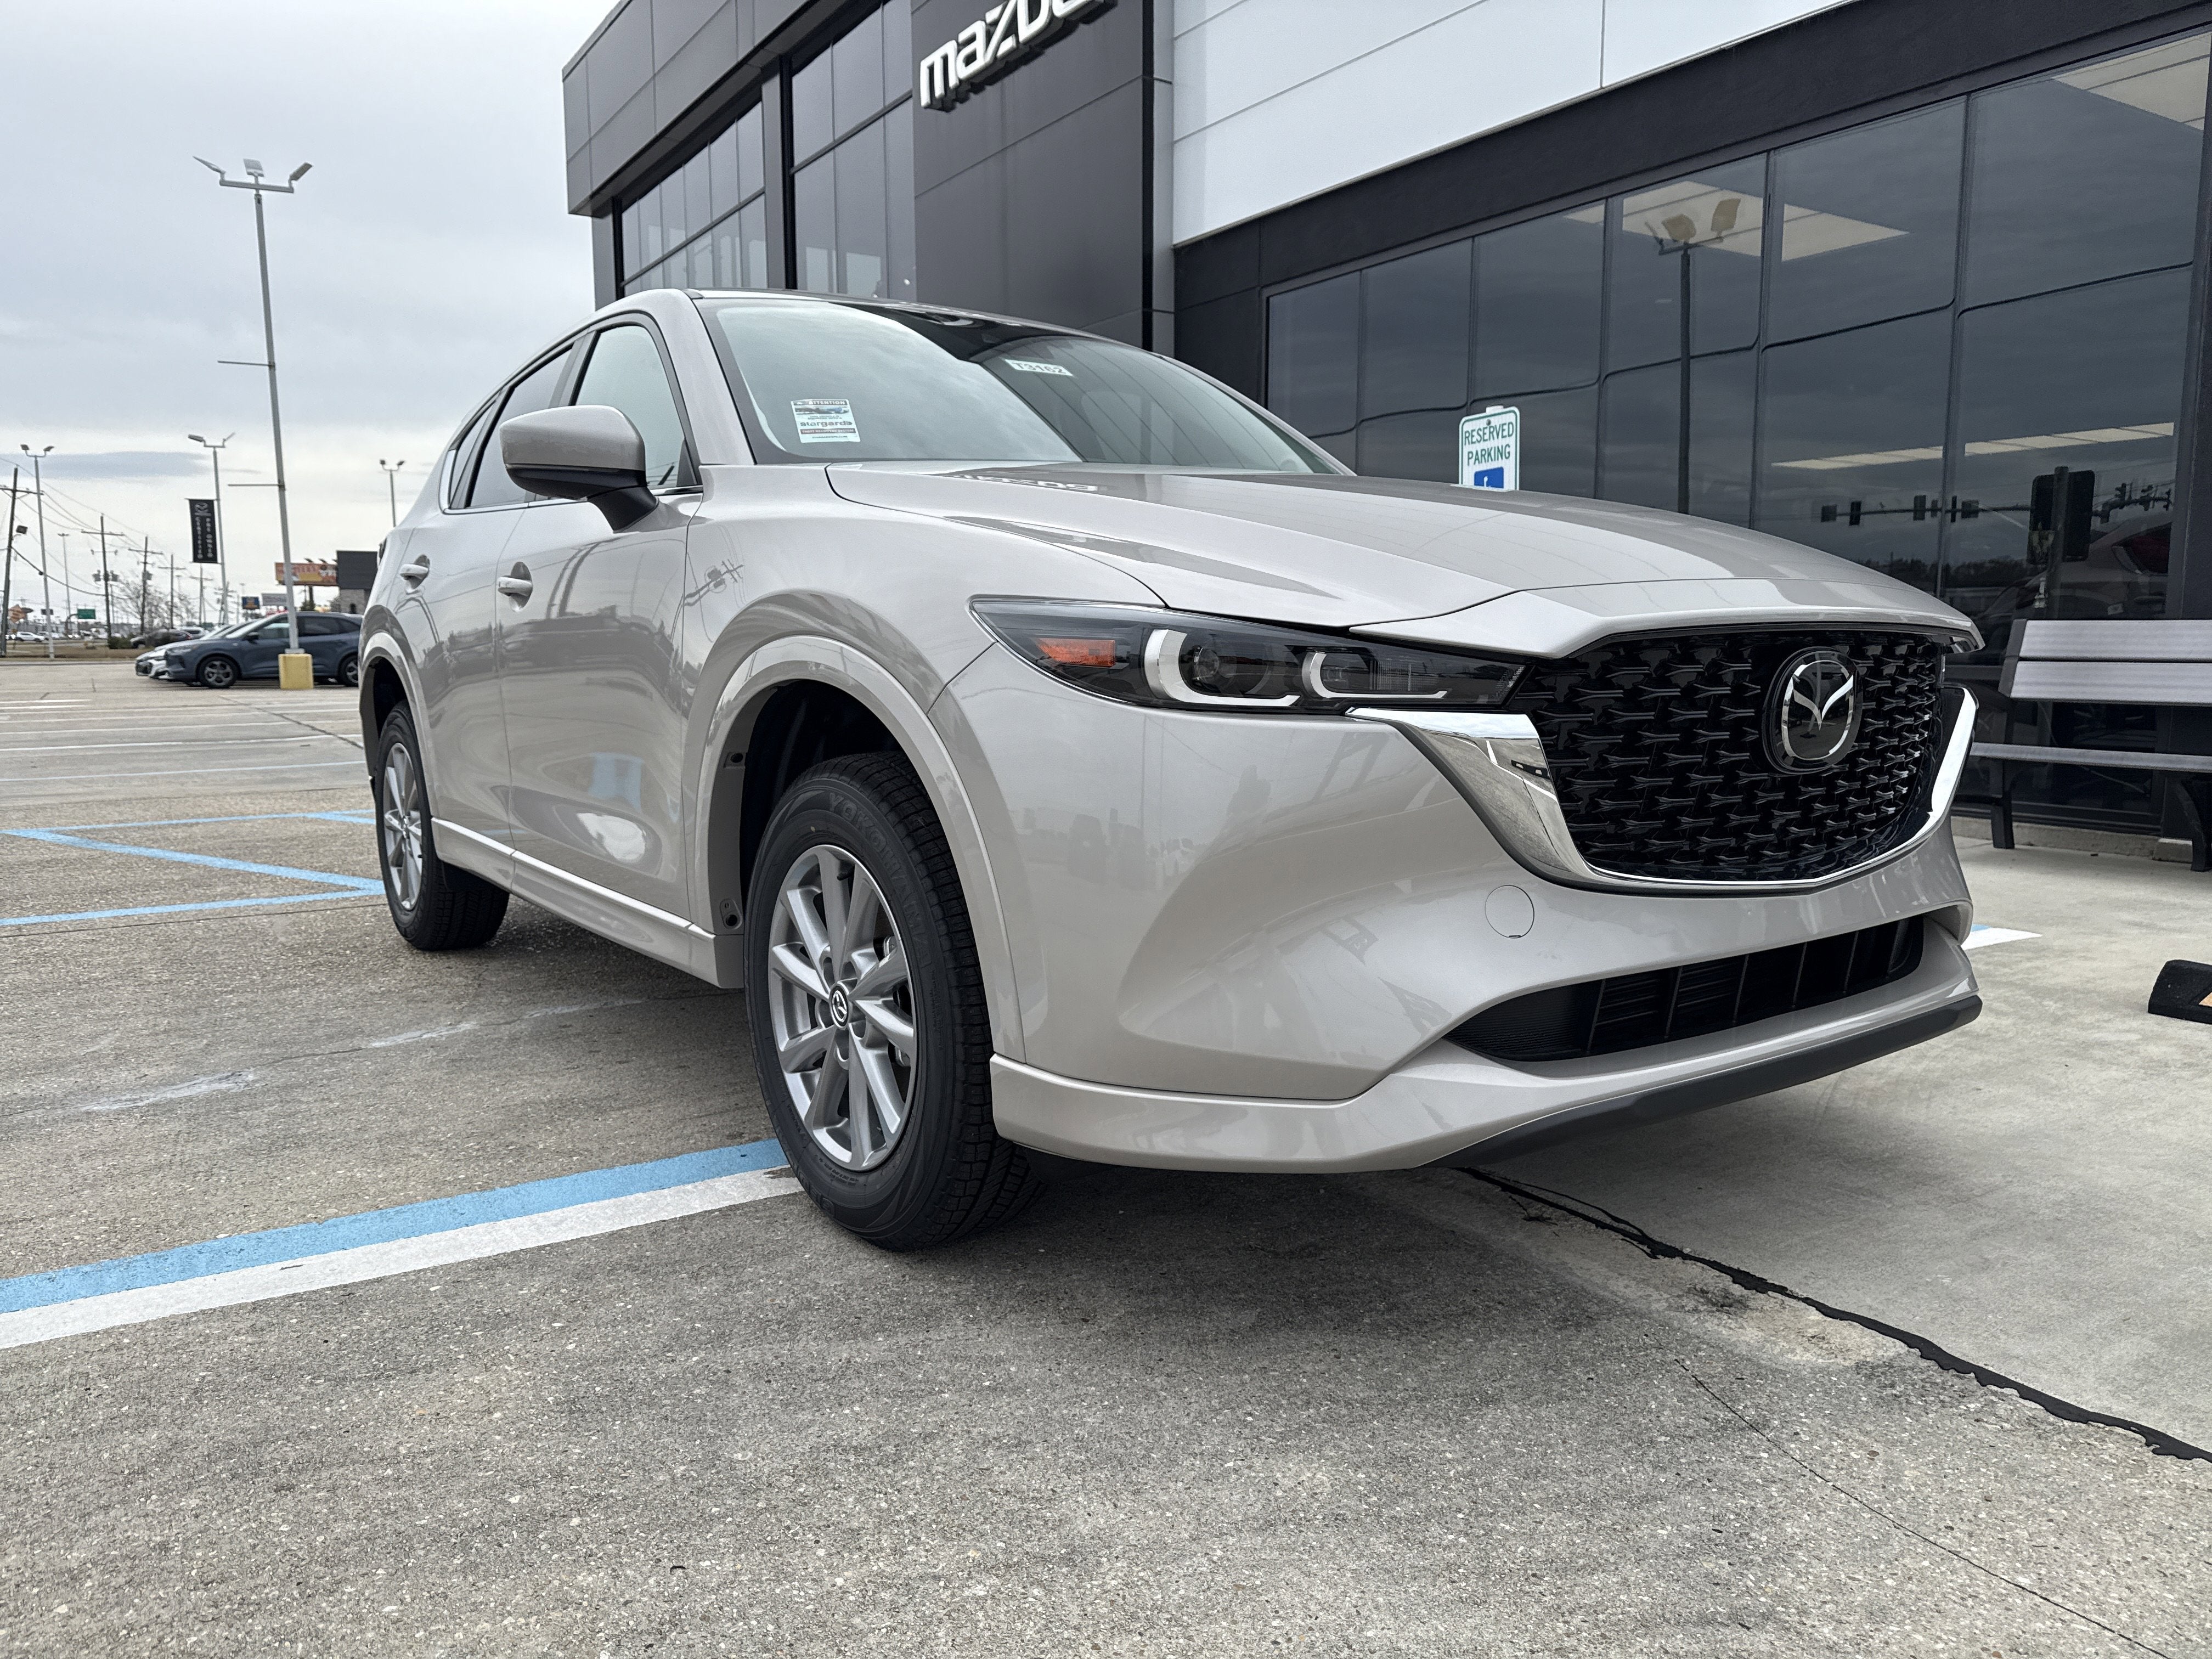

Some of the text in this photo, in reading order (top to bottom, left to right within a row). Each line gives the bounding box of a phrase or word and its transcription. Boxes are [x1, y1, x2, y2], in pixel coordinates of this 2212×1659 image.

[1012, 363, 1066, 374] T3162
[1464, 421, 1514, 446] RESERVED
[1467, 444, 1510, 466] PARKING
